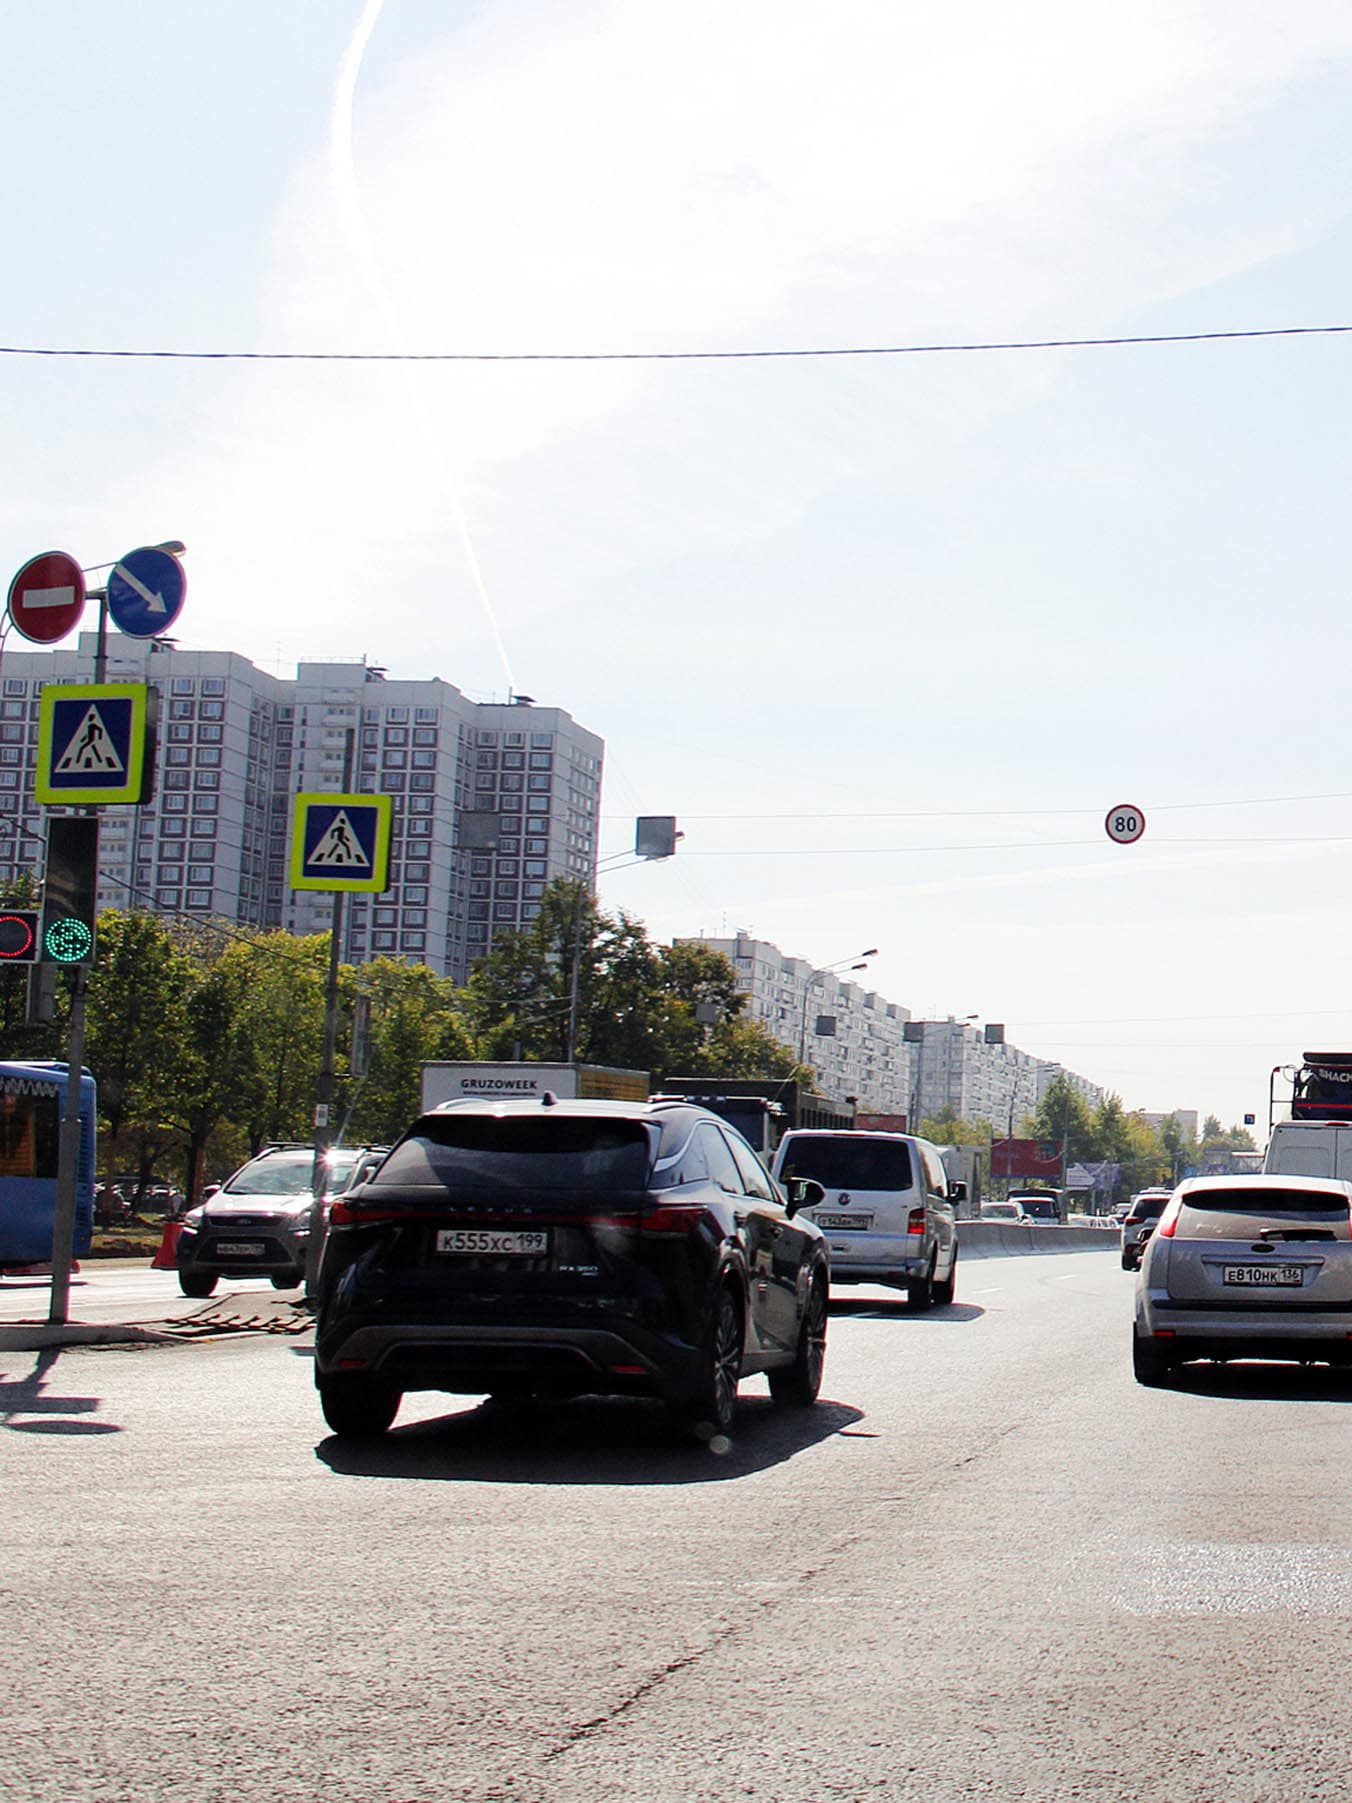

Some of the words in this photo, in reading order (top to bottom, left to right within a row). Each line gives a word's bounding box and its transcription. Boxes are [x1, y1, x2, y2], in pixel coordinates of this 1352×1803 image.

[1115, 816, 1137, 833] 80
[461, 1079, 537, 1090] GRUZOWEEK
[517, 1233, 544, 1248] 199
